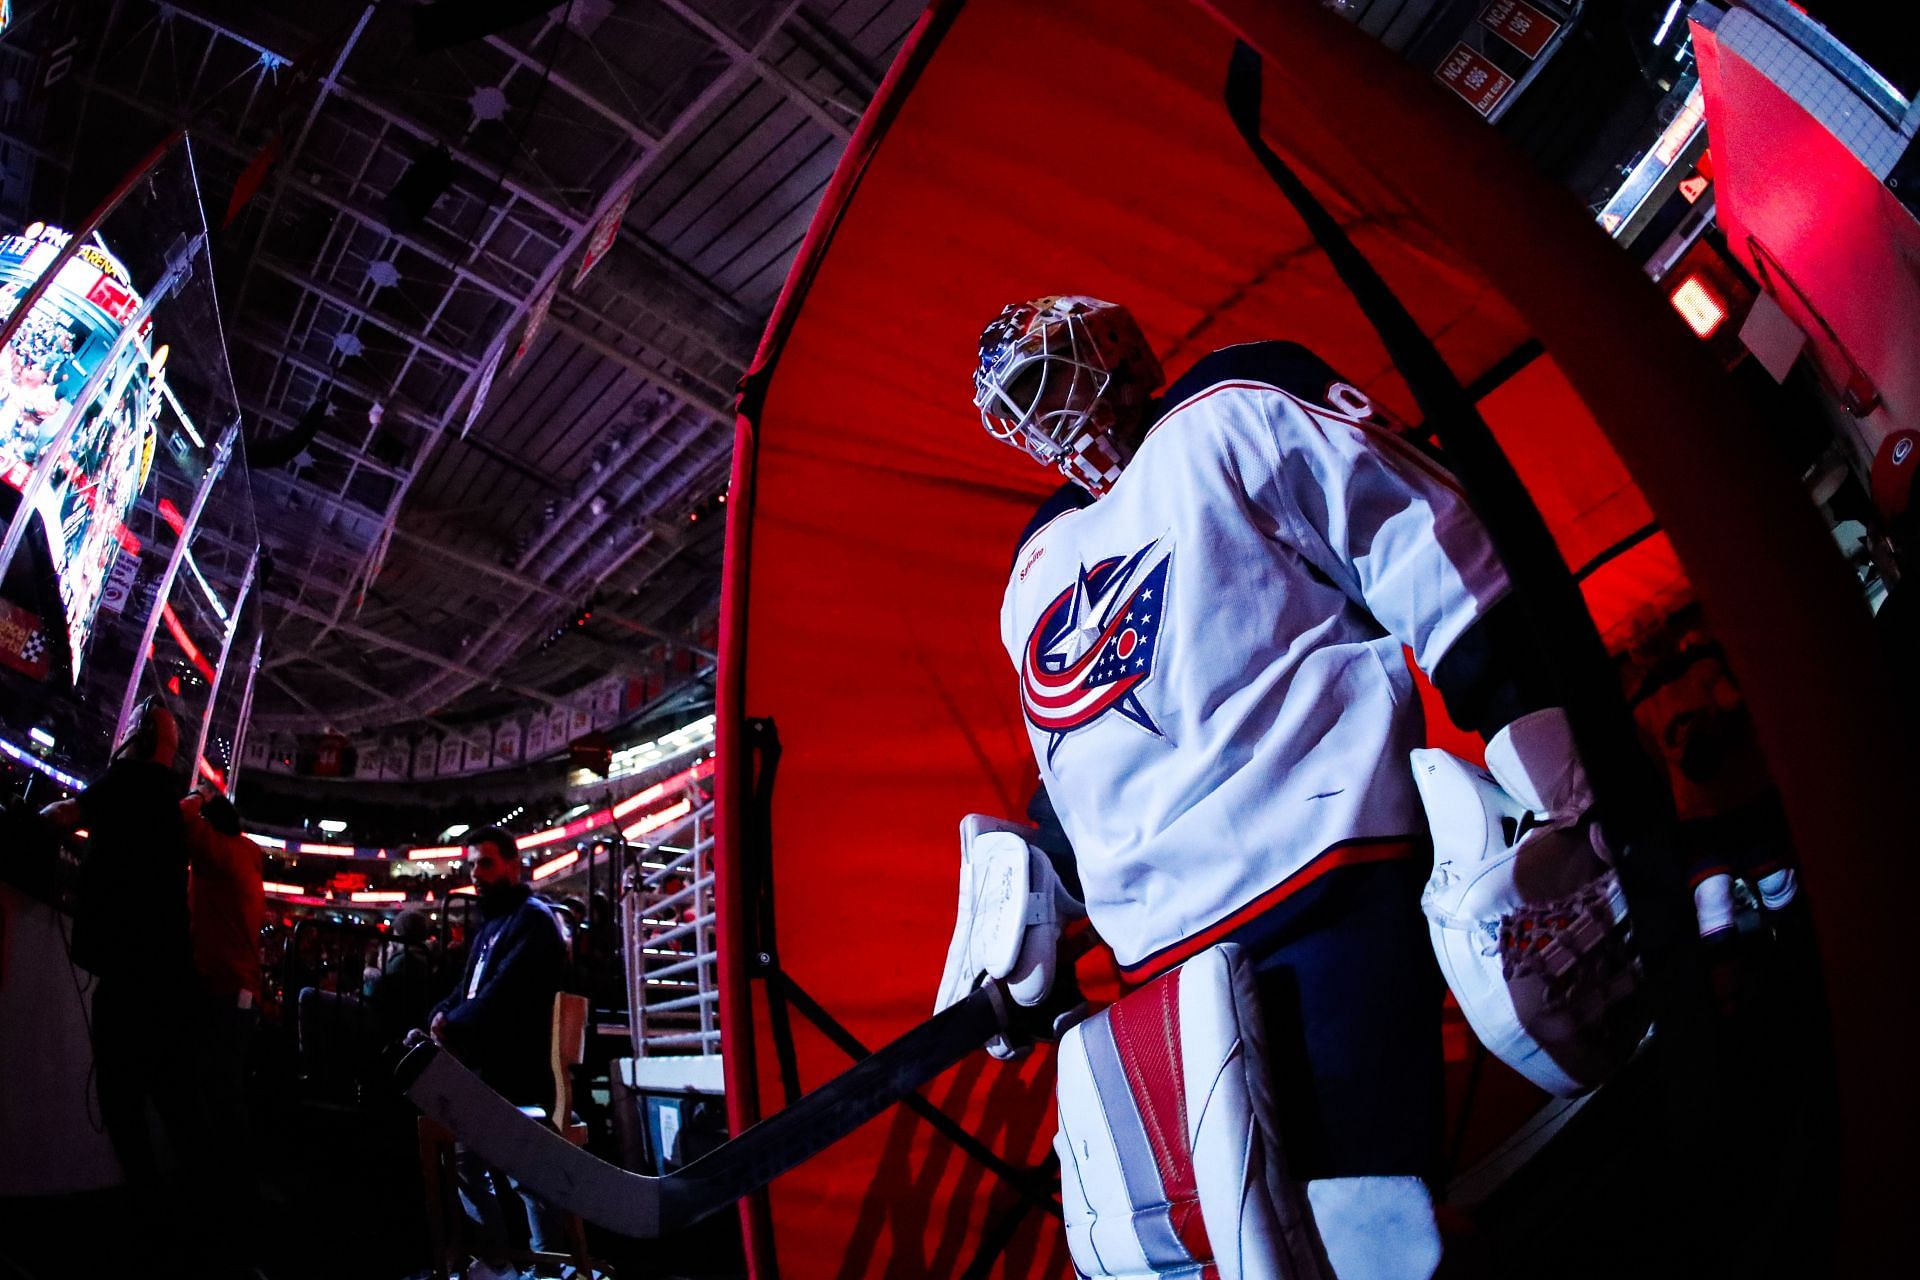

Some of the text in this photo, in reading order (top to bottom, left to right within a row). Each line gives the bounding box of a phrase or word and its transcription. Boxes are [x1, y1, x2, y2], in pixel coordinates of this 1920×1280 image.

[1507, 11, 1533, 36] 1987
[1442, 50, 1473, 81] NCAA
[76, 246, 118, 278] ARENA
